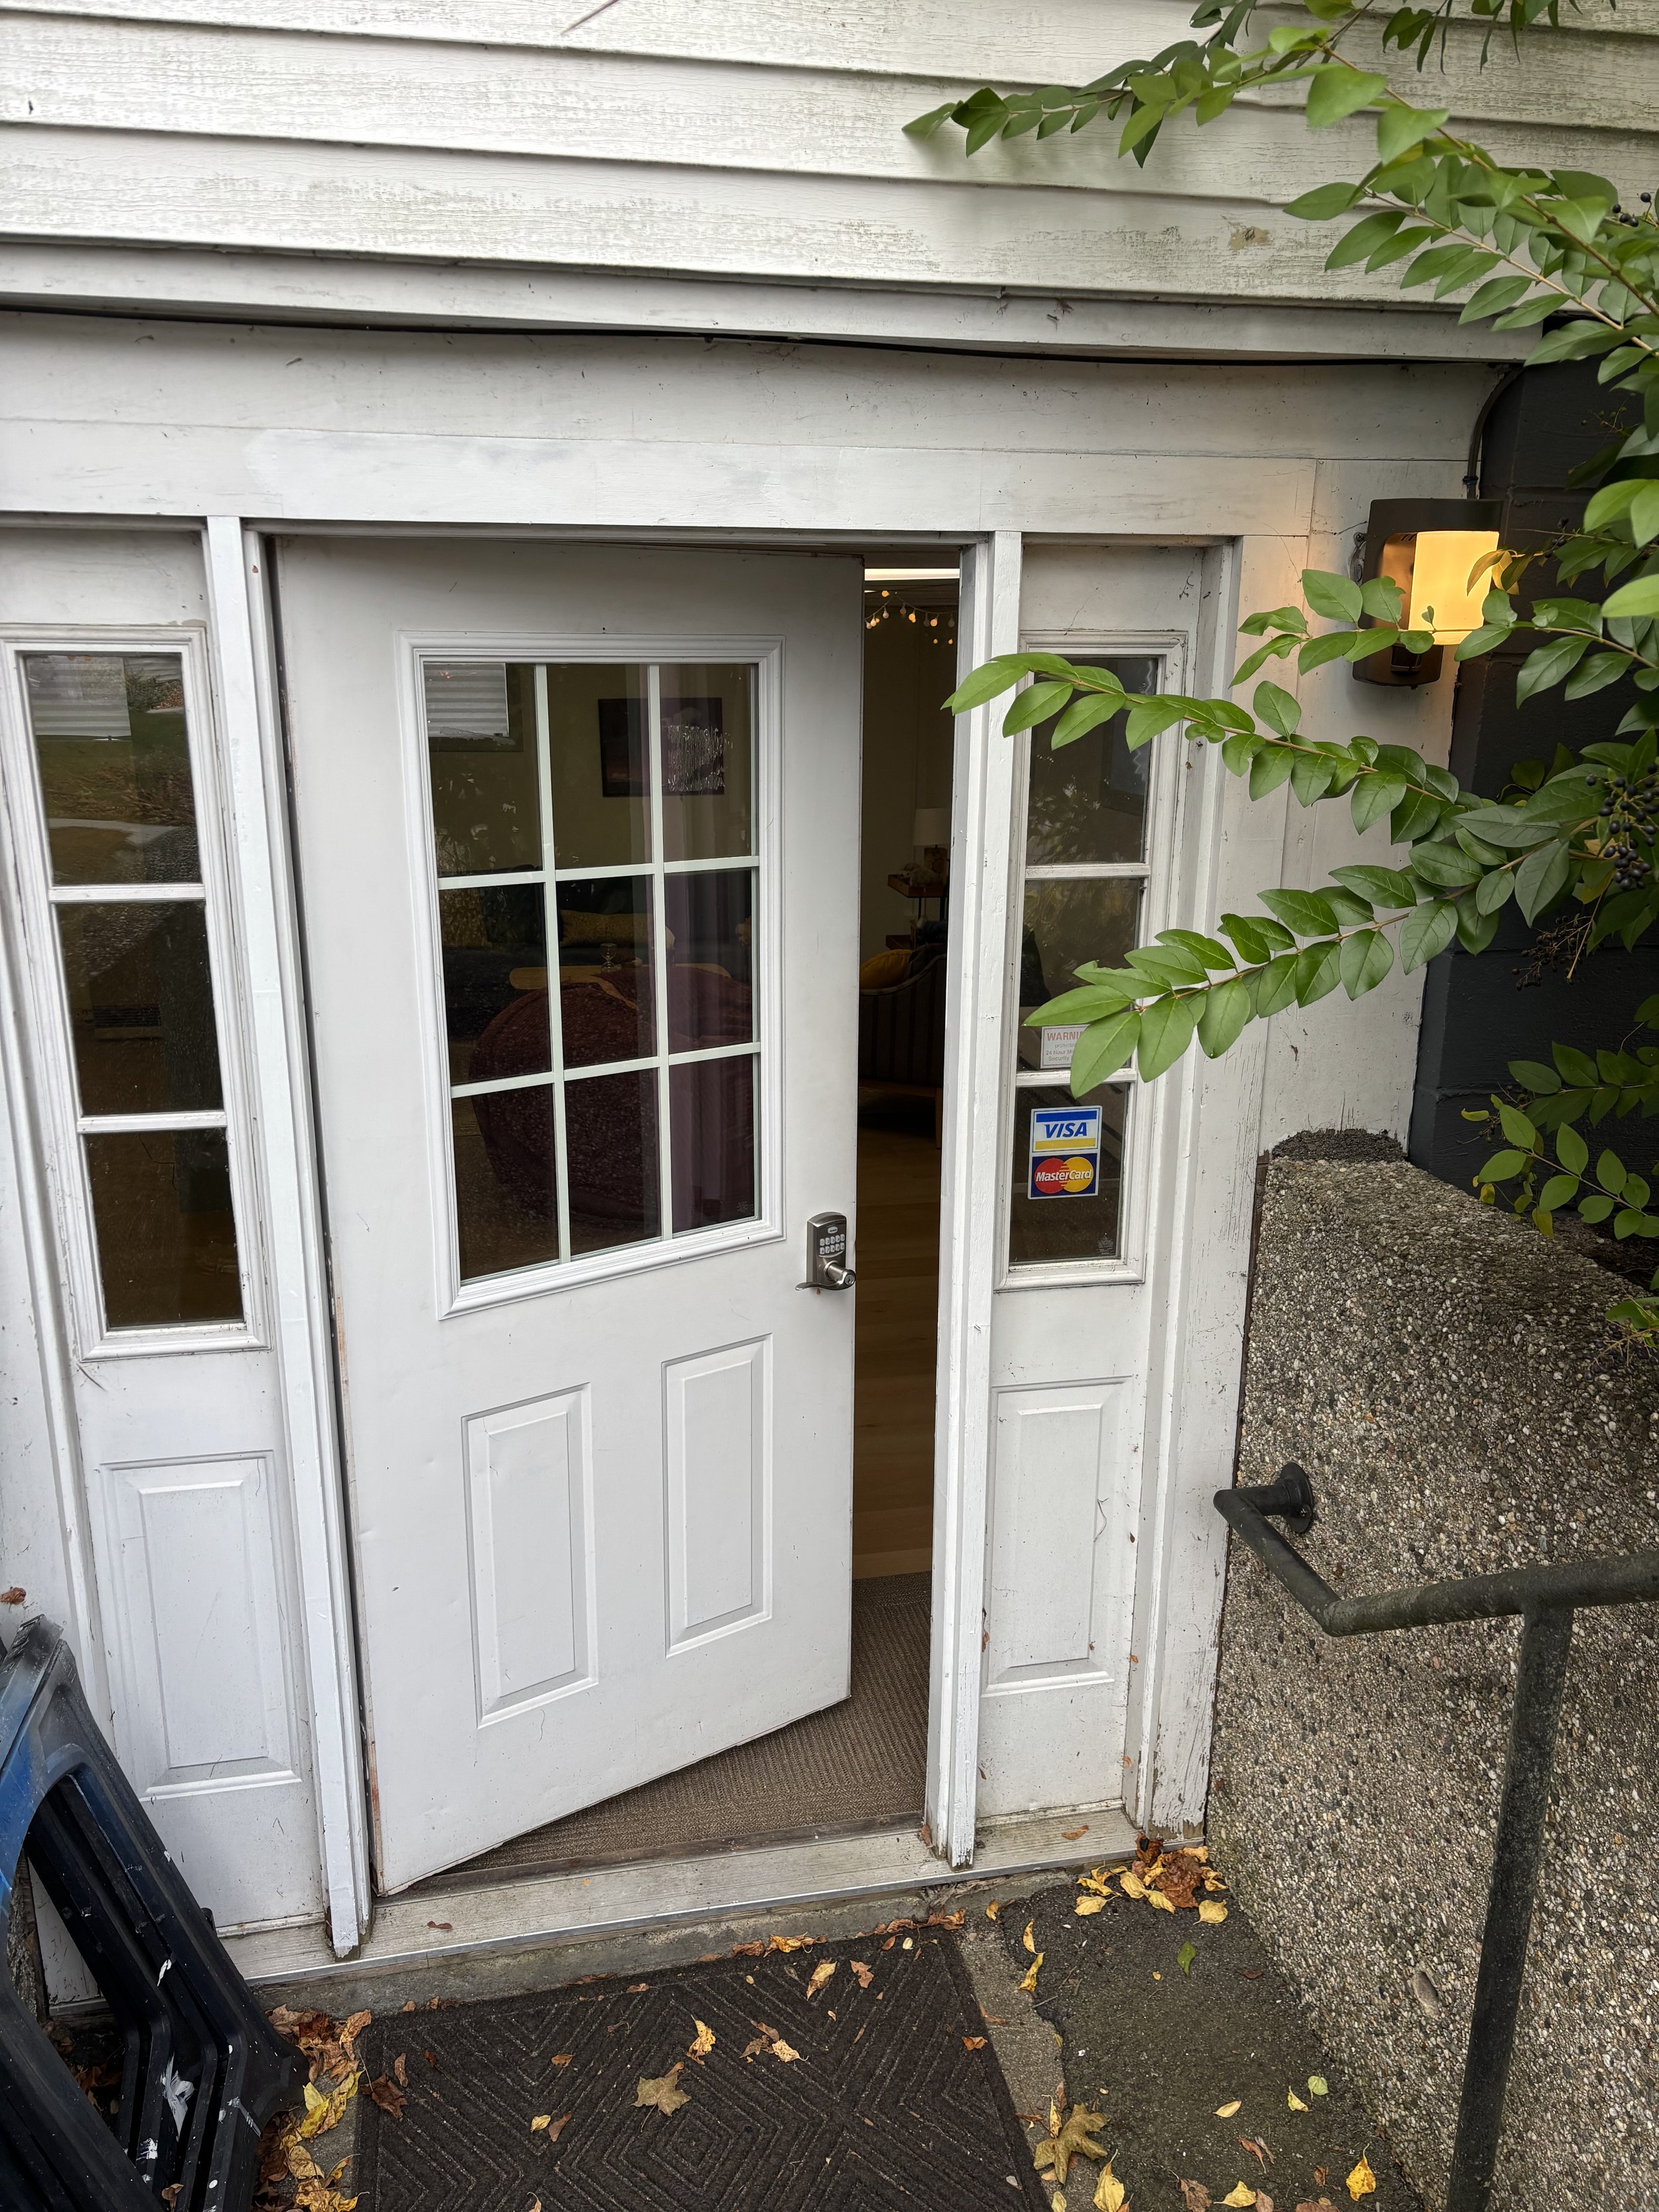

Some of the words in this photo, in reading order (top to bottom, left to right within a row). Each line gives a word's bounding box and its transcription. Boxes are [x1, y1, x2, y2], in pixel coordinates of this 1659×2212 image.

[1047, 1031, 1083, 1041] WARNI
[1044, 1122, 1088, 1138] VISA
[1035, 1169, 1092, 1182] MasterCard
